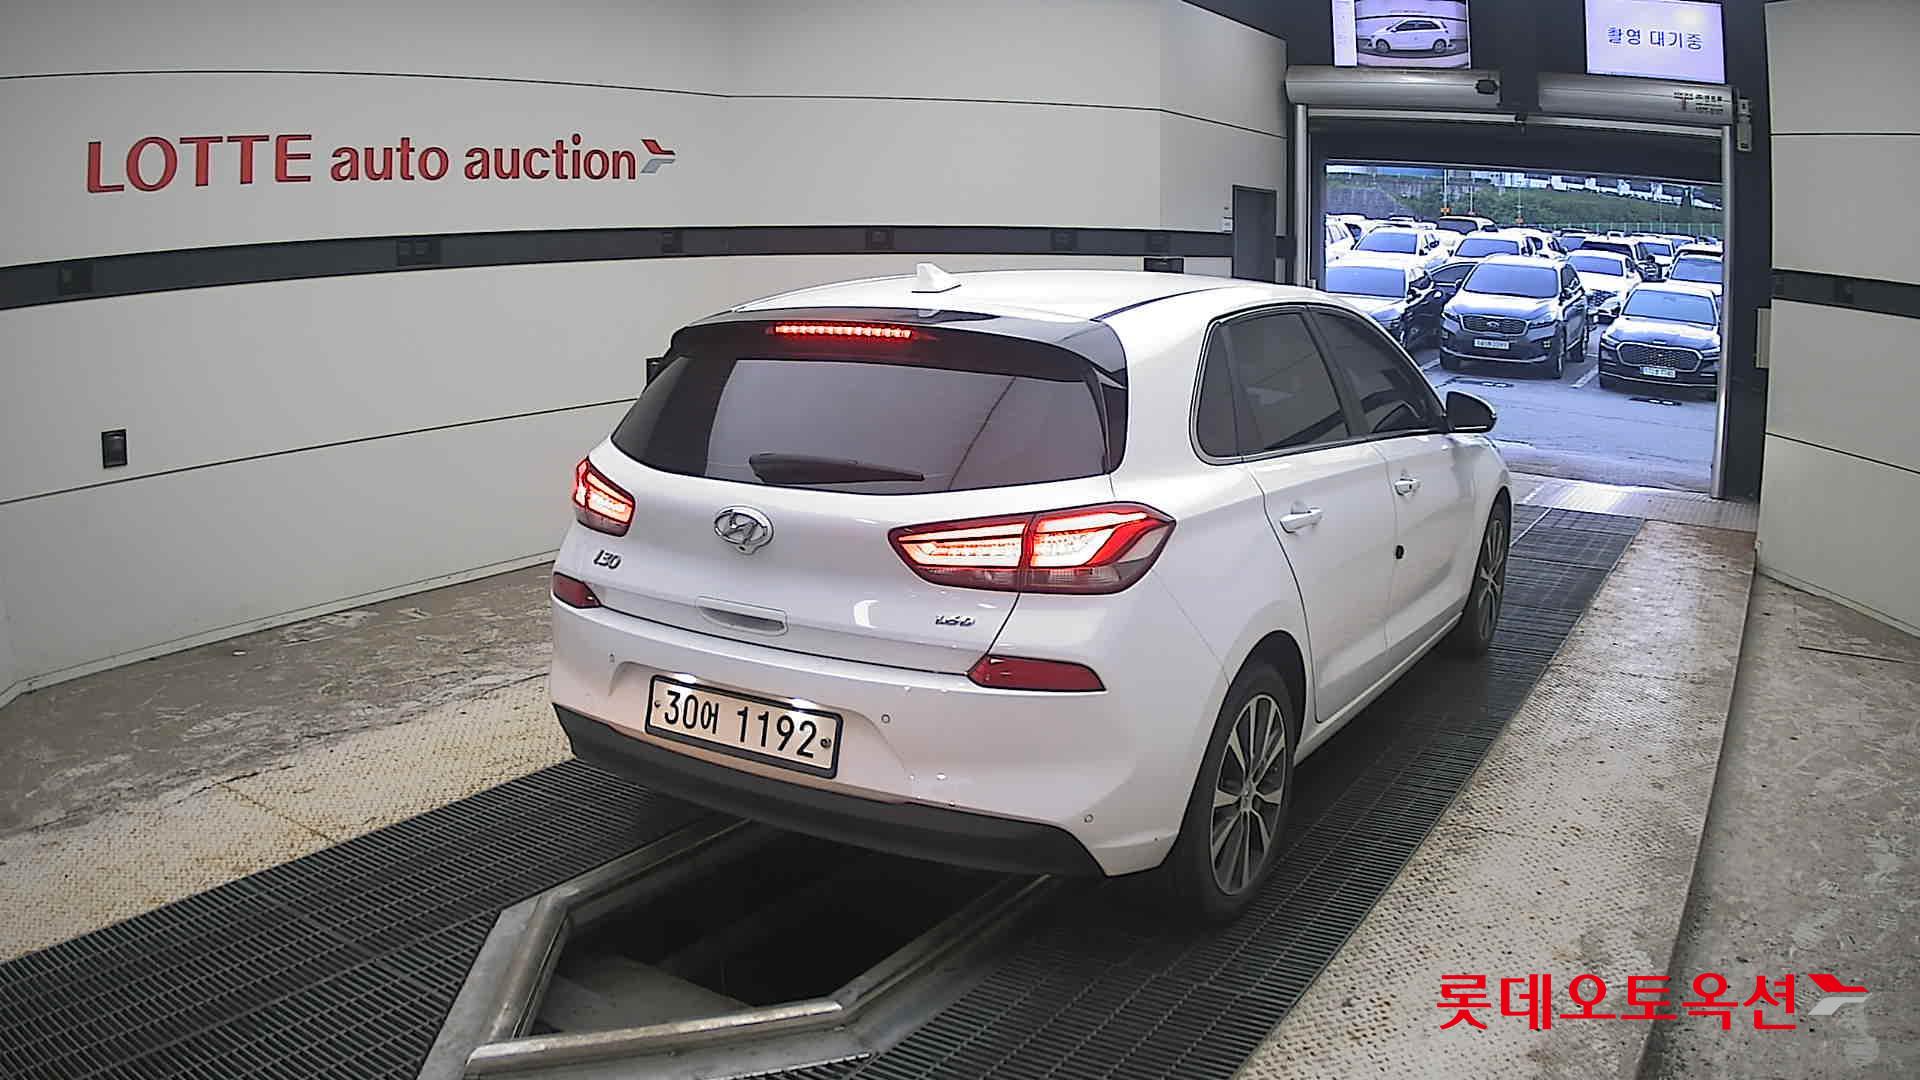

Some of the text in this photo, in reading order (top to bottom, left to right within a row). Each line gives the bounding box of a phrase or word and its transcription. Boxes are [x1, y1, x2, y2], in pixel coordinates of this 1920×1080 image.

[87, 133, 637, 194] LOTTE auto auction
[664, 689, 817, 759] 30어 1192
